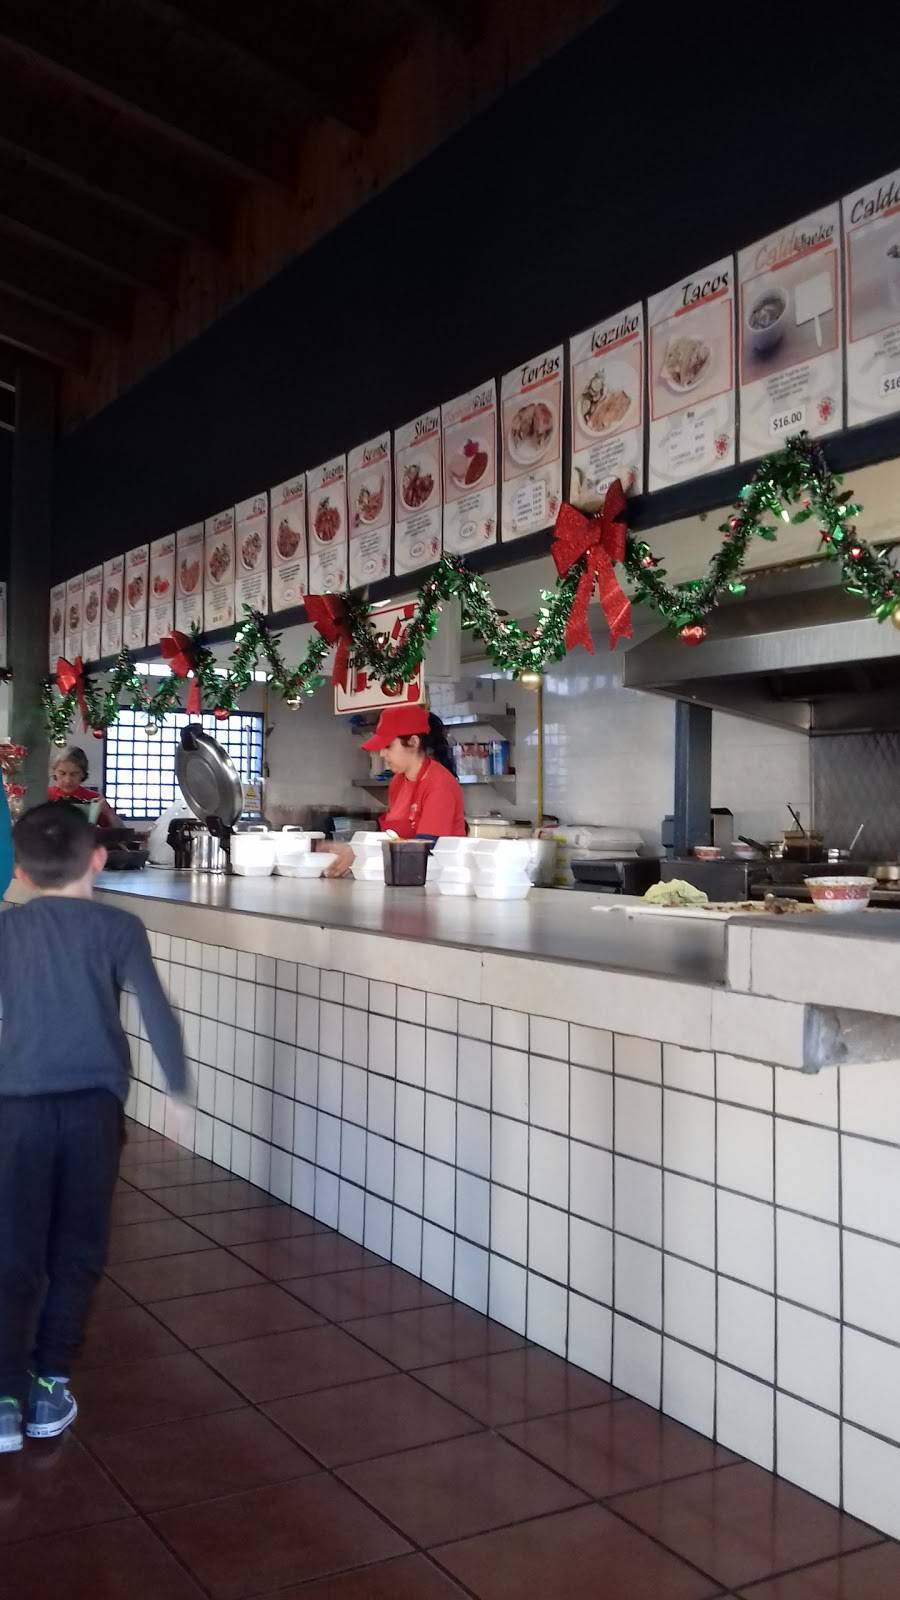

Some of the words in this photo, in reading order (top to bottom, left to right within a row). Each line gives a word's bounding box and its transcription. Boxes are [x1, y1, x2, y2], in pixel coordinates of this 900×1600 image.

[681, 271, 729, 306] Tacos
[520, 356, 560, 386] Tortas
[772, 411, 802, 431] $16.00
